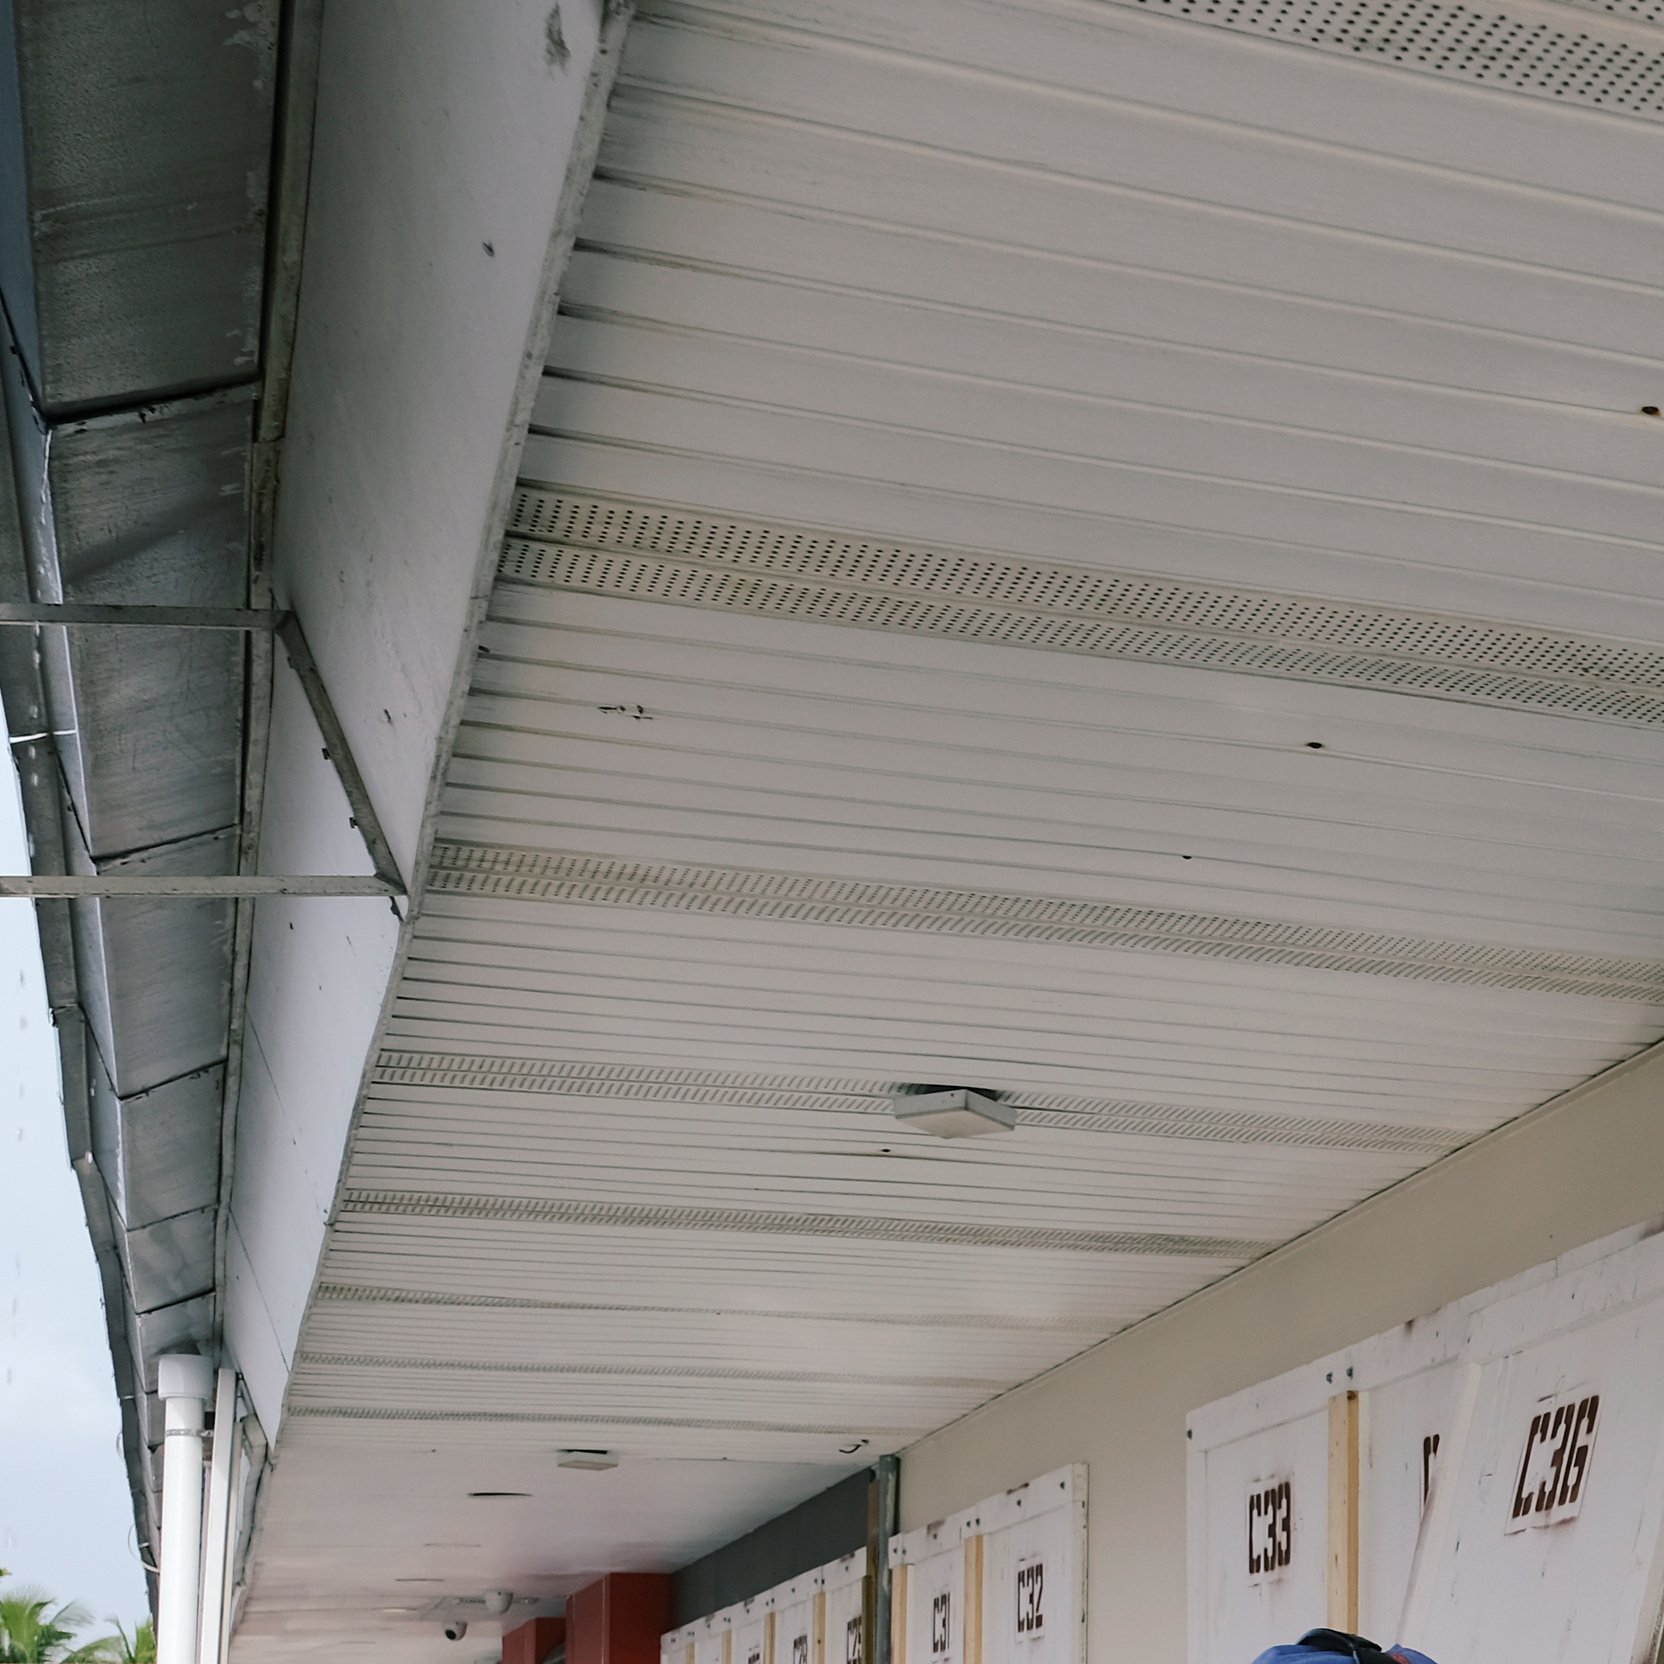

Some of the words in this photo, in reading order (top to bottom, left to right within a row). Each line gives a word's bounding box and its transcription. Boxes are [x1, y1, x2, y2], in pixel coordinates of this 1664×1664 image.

[1512, 1395, 1599, 1519] C36
[1248, 1482, 1291, 1575] C33
[932, 1591, 951, 1654] C31
[1017, 1564, 1044, 1633] C32
